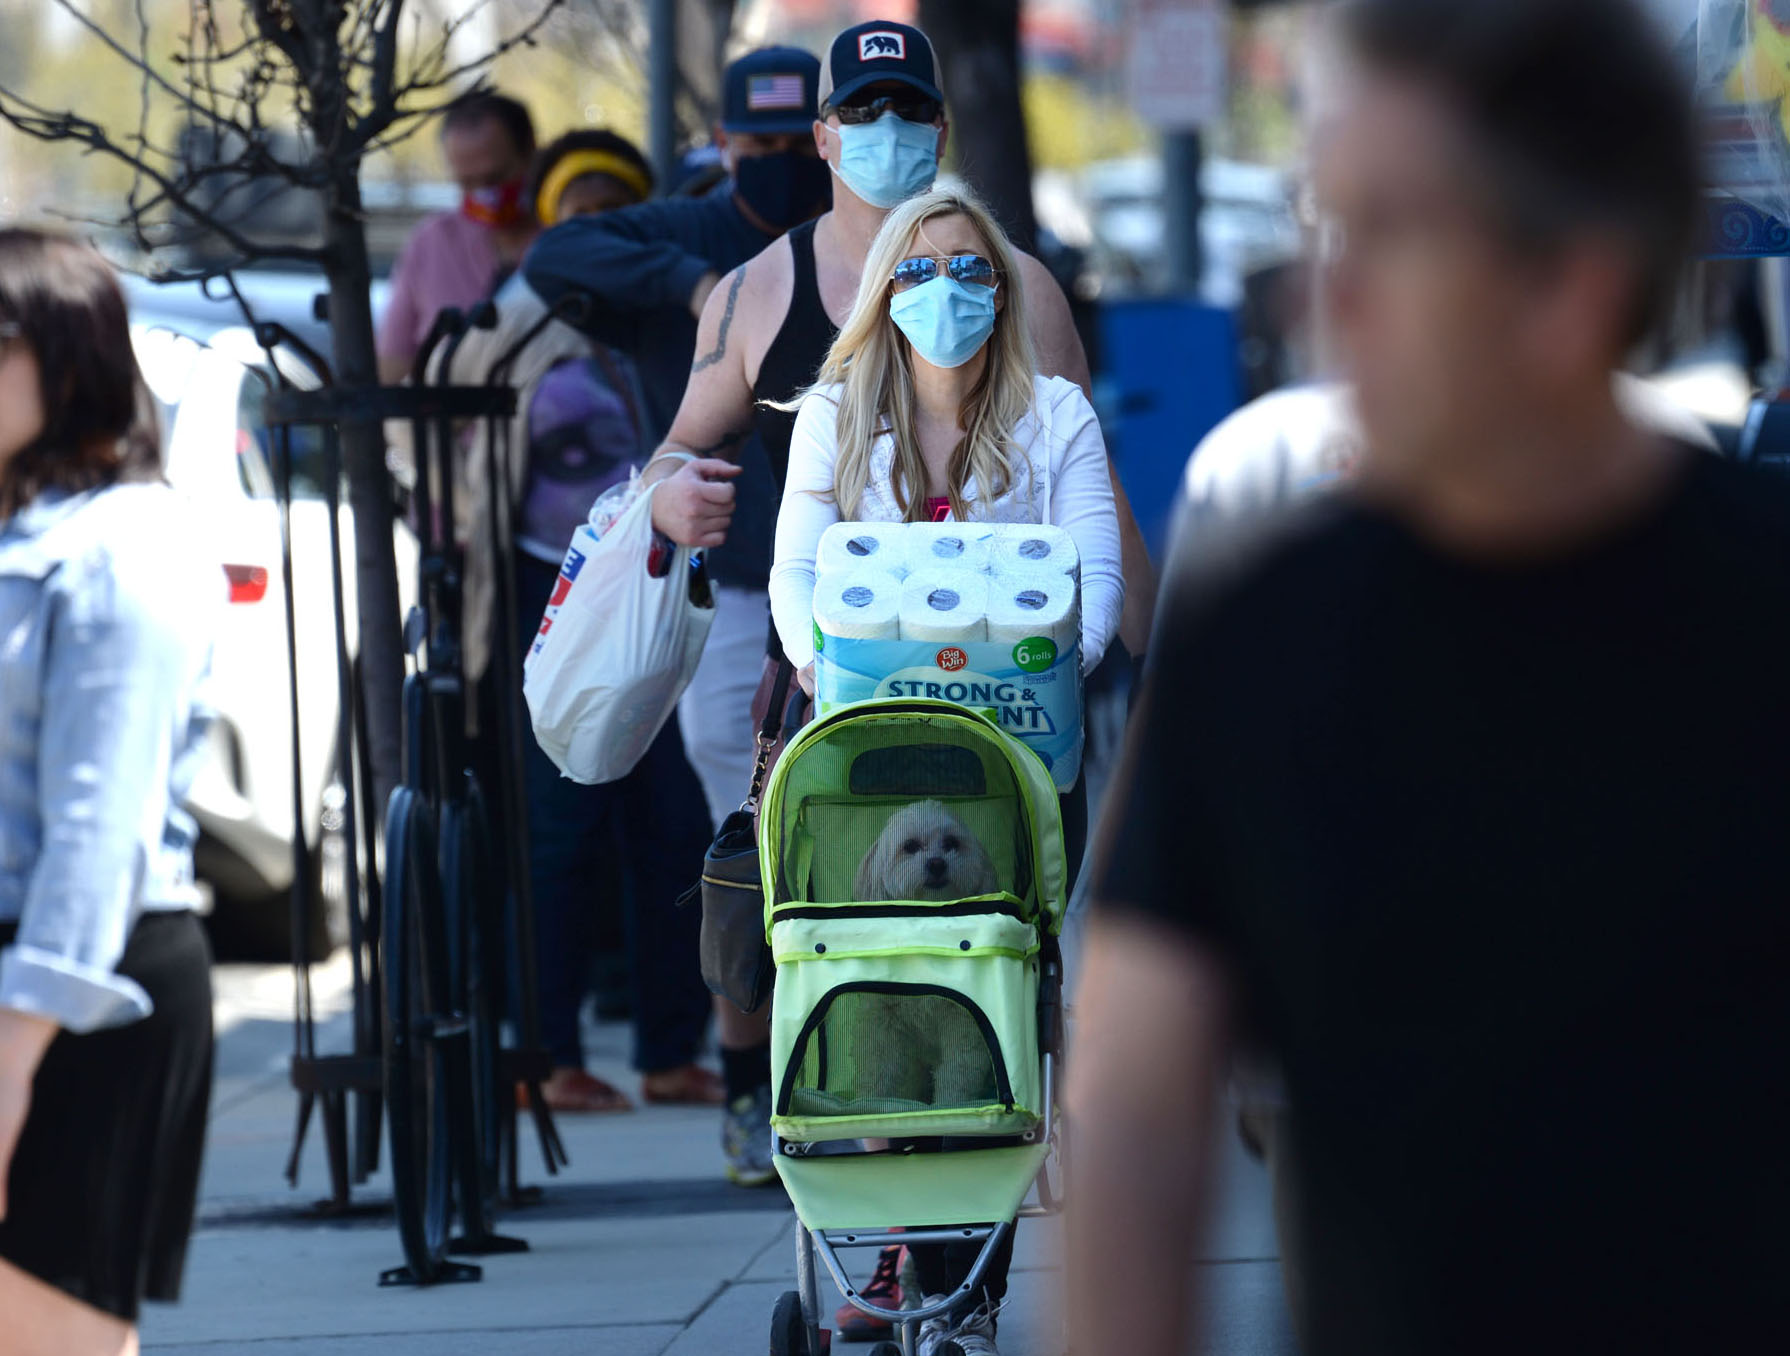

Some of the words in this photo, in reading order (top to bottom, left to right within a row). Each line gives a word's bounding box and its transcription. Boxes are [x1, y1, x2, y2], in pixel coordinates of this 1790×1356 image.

[941, 650, 960, 660] Big
[1016, 646, 1030, 664] 6
[1032, 651, 1052, 661] rolls
[941, 657, 964, 669] Win
[888, 681, 1015, 702] STRONG
[1021, 688, 1037, 701] &
